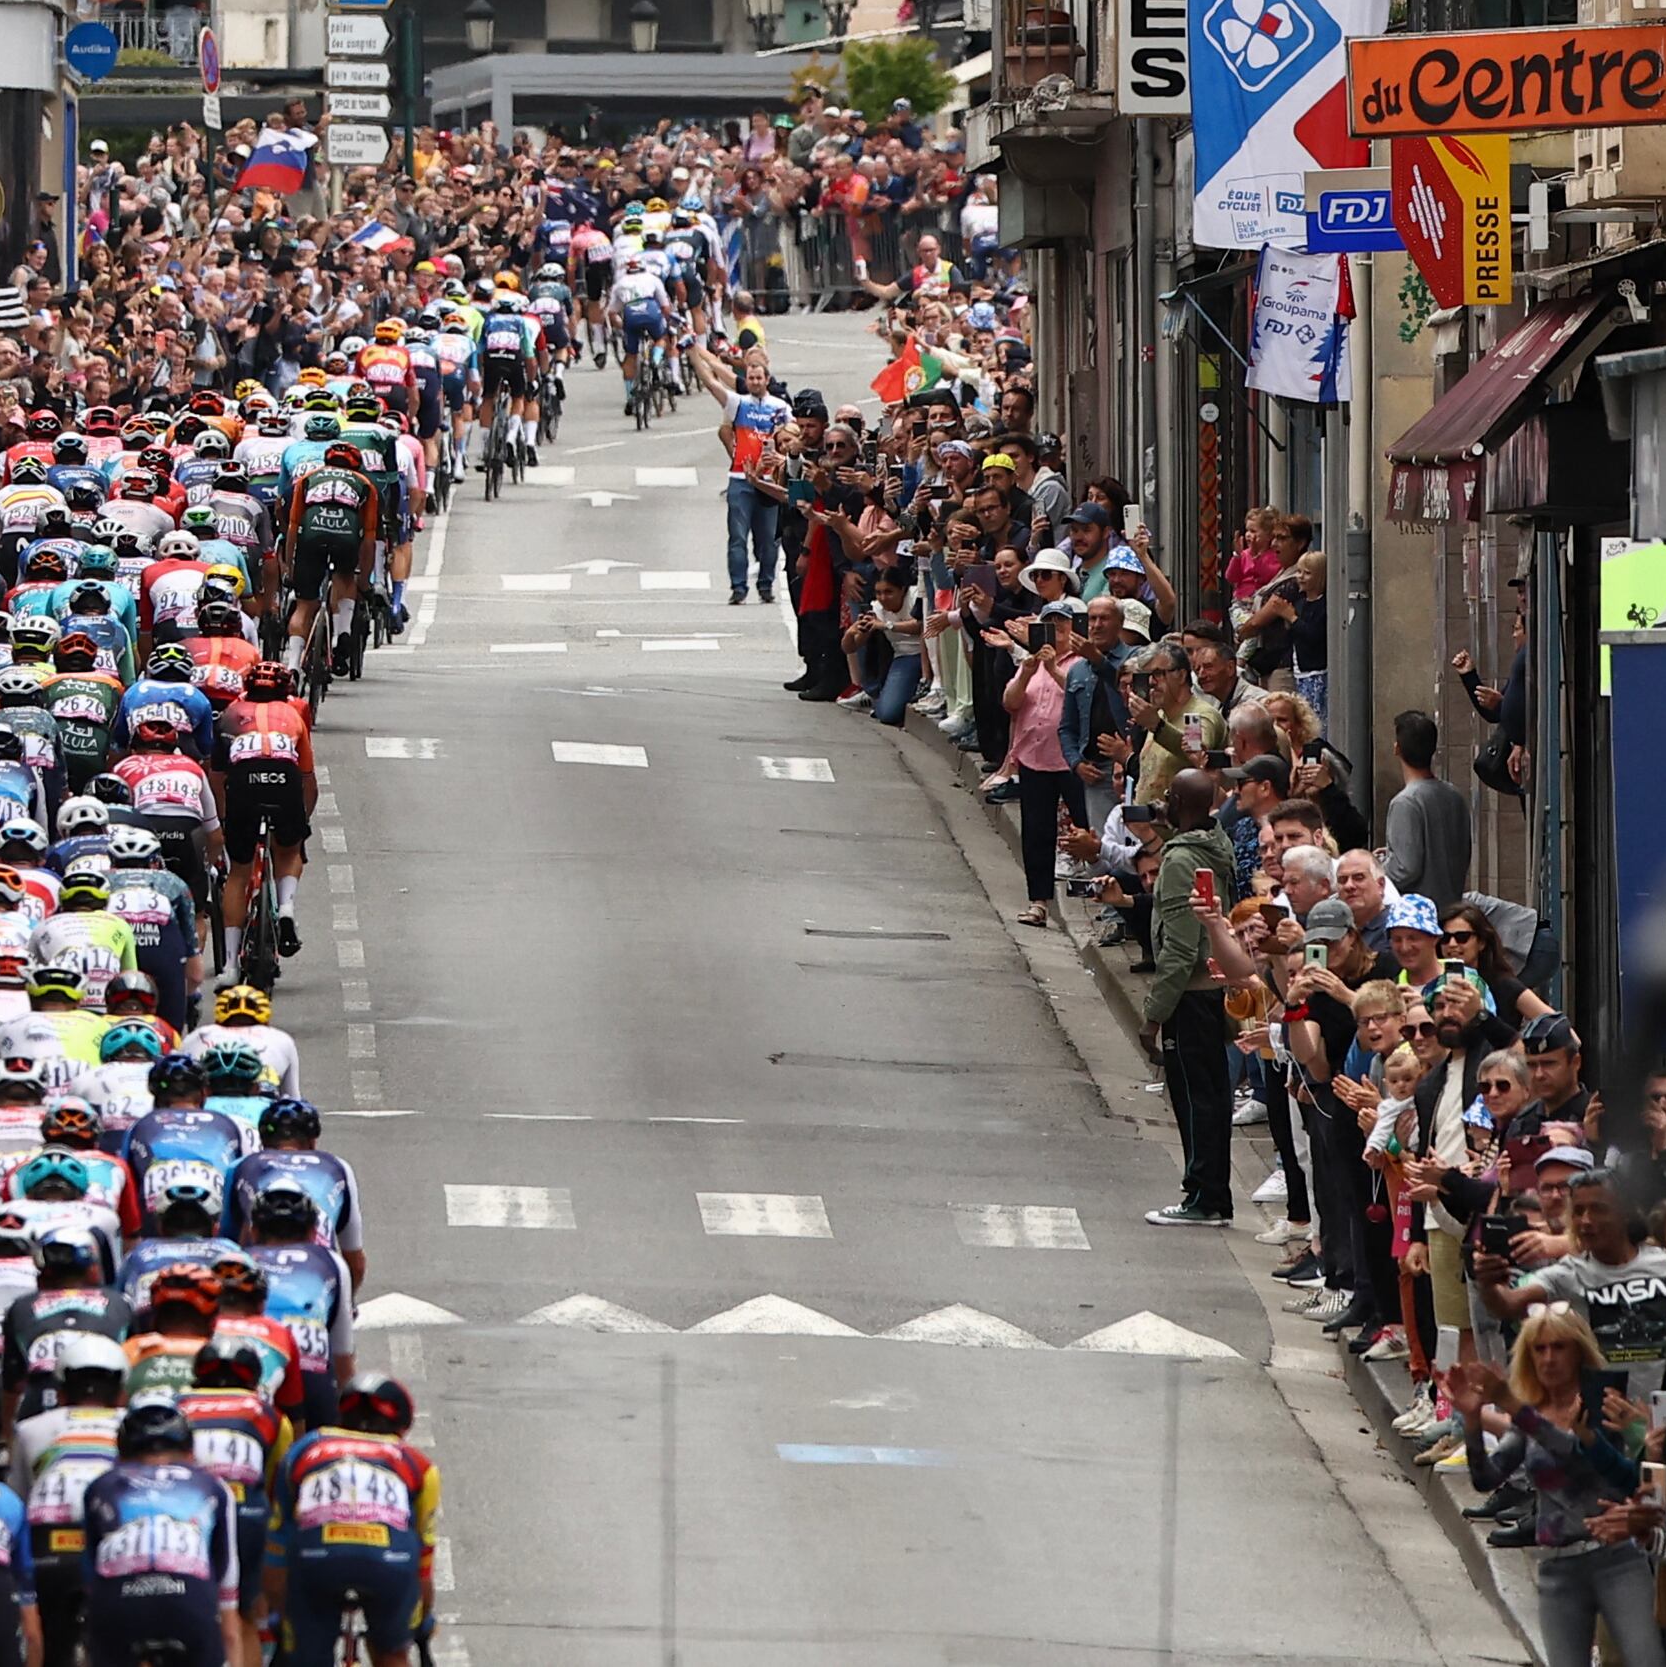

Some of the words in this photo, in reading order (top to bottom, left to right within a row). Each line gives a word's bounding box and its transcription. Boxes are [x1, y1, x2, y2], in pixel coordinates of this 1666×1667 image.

[71, 43, 111, 55] Audika
[1361, 77, 1404, 125] du
[1410, 38, 1666, 125] Centre
[1327, 197, 1386, 224] FDJ
[1475, 196, 1501, 301] PRESSE
[1262, 295, 1327, 322] Groupama
[1264, 318, 1293, 336] FDJ
[311, 514, 351, 528] ALULA
[160, 591, 178, 609] 92
[56, 684, 103, 697] ALULA
[61, 697, 81, 712] 26
[236, 737, 255, 752] 37
[248, 771, 286, 785] INEOS
[6, 799, 24, 819] 13
[115, 892, 127, 911] 3
[148, 891, 159, 910] 3
[106, 1095, 131, 1114] 62
[311, 1475, 341, 1502] 48
[368, 1475, 399, 1504] 48
